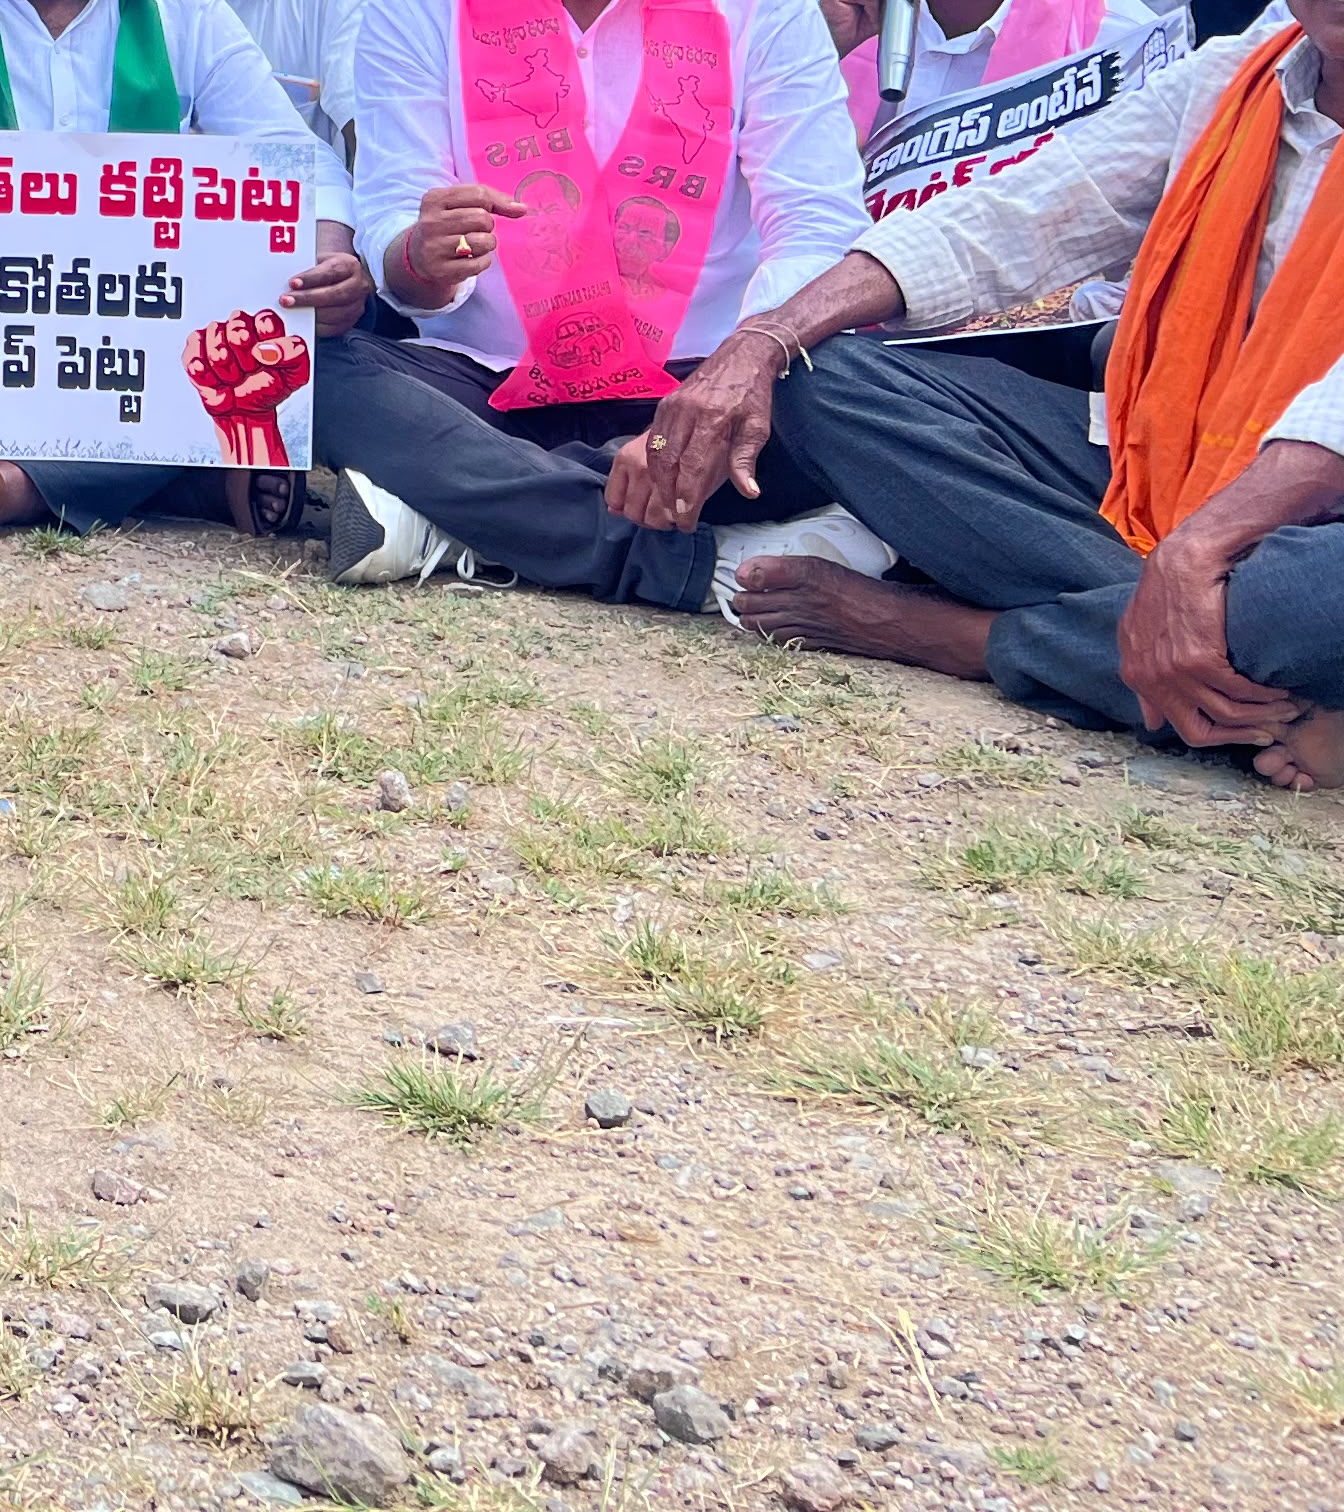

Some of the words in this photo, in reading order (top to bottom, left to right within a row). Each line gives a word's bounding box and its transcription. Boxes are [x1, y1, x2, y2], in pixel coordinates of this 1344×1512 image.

[868, 102, 993, 183] కాంగ్రెస్
[997, 50, 1104, 139] అంటేనే
[56, 335, 145, 423] పెట్టు
